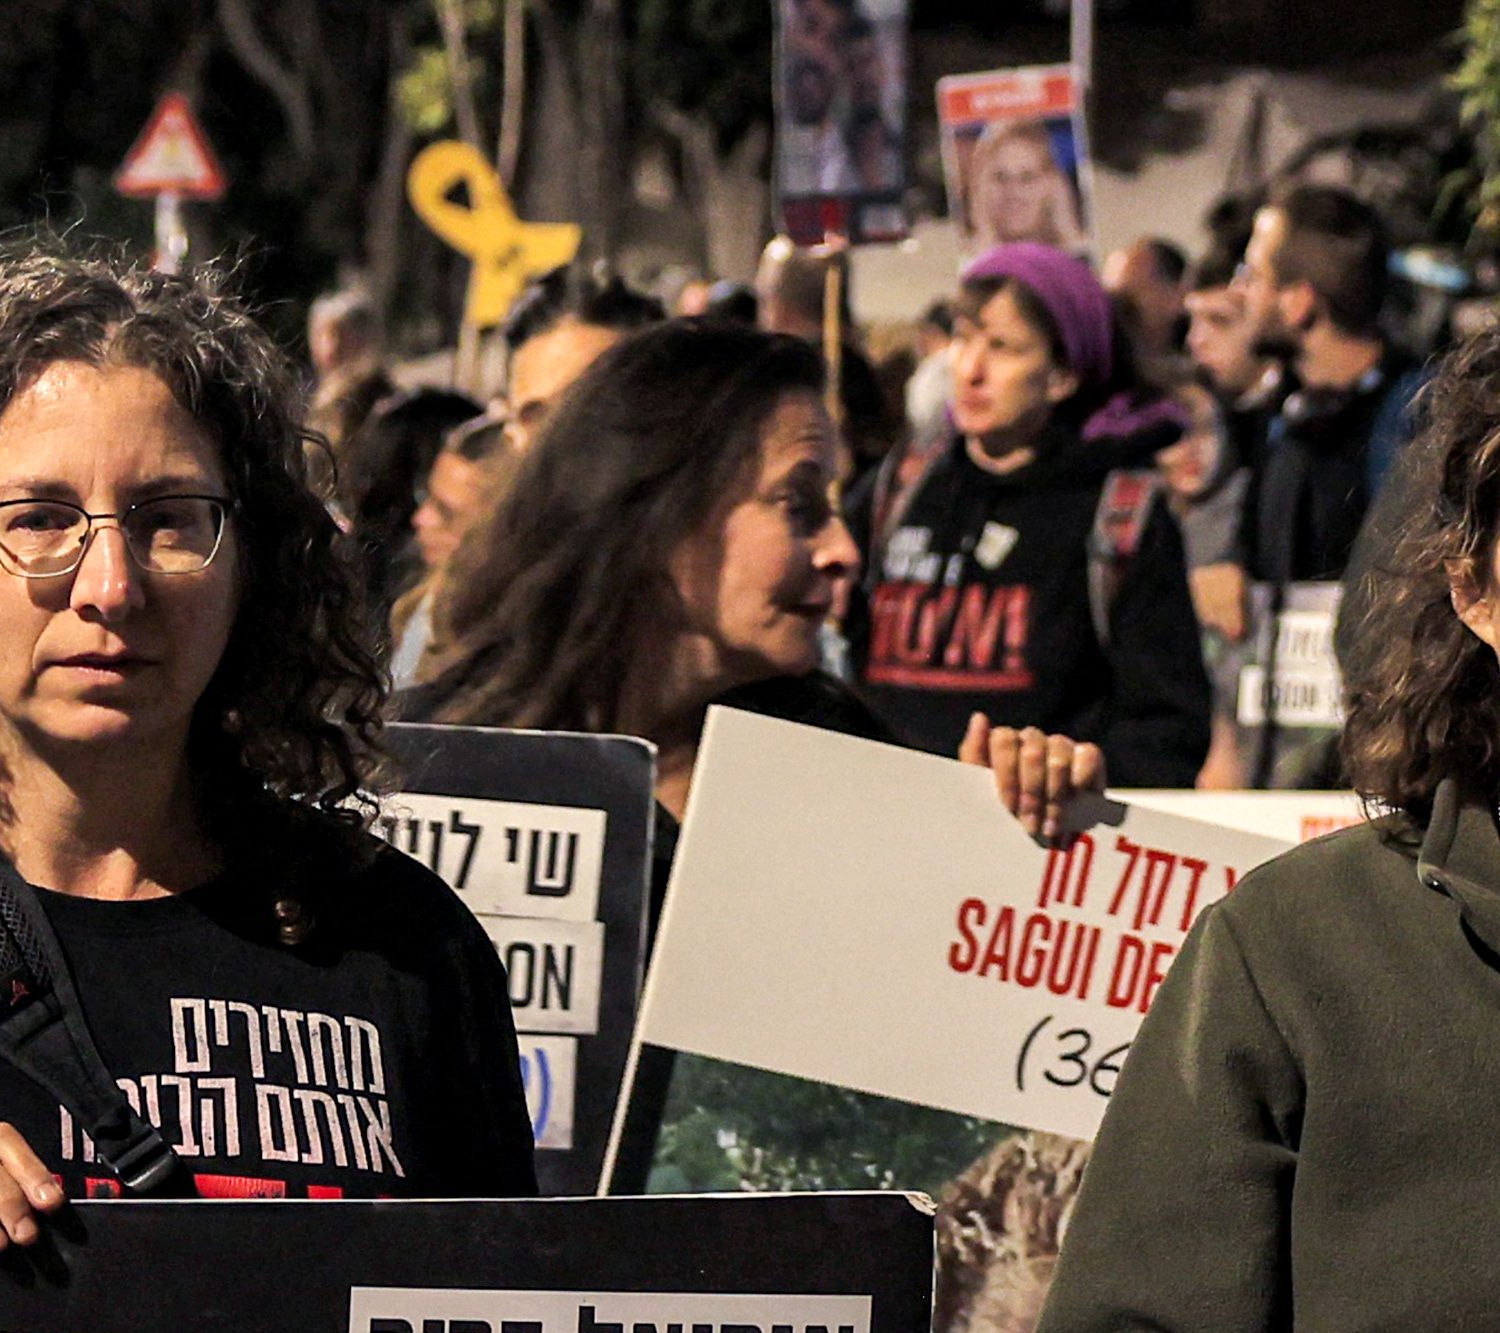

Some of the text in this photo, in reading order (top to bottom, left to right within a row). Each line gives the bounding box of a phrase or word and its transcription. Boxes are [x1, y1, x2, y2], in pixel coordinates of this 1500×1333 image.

[504, 826, 580, 899] שי
[1107, 833, 1209, 933] דקל
[947, 896, 1103, 1001] SAGUI
[169, 997, 387, 1096] מחזירים
[254, 1083, 406, 1178] אותם
